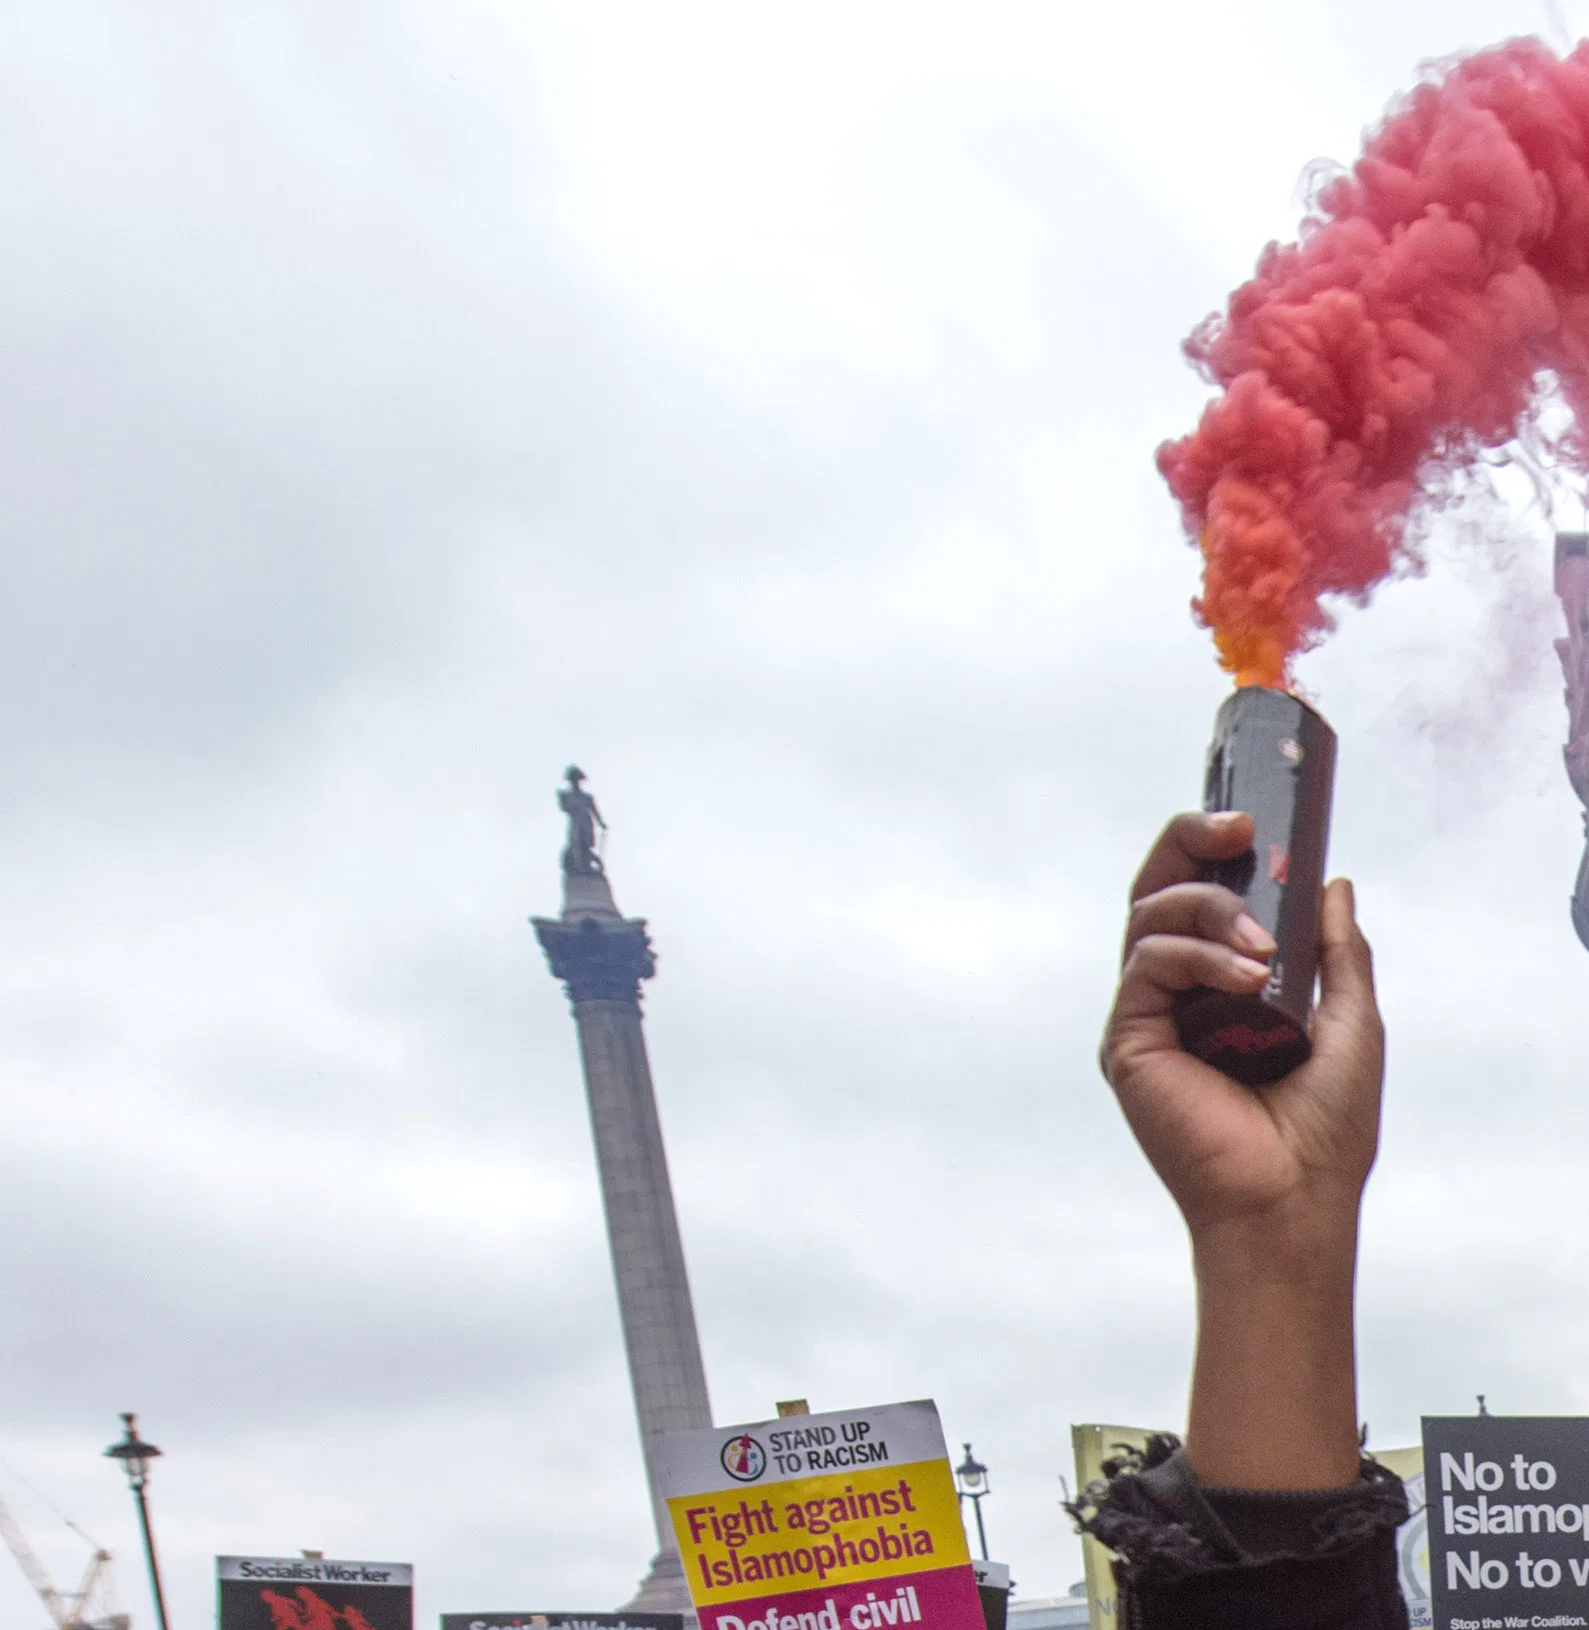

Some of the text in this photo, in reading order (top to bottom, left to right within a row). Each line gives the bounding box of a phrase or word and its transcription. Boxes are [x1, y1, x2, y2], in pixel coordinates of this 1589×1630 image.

[769, 1421, 871, 1453] STAND UP
[773, 1442, 888, 1474] TO RACISM
[1440, 1452, 1557, 1491] No to
[685, 1479, 916, 1549] Fight against
[697, 1523, 934, 1589] Islamophobia
[1446, 1550, 1509, 1590] No
[1515, 1552, 1561, 1588] to
[850, 1586, 922, 1630] civil
[1450, 1618, 1480, 1630] Stop
[1482, 1617, 1502, 1629] the
[1504, 1617, 1529, 1628] War
[1531, 1615, 1587, 1628] Coalition.
